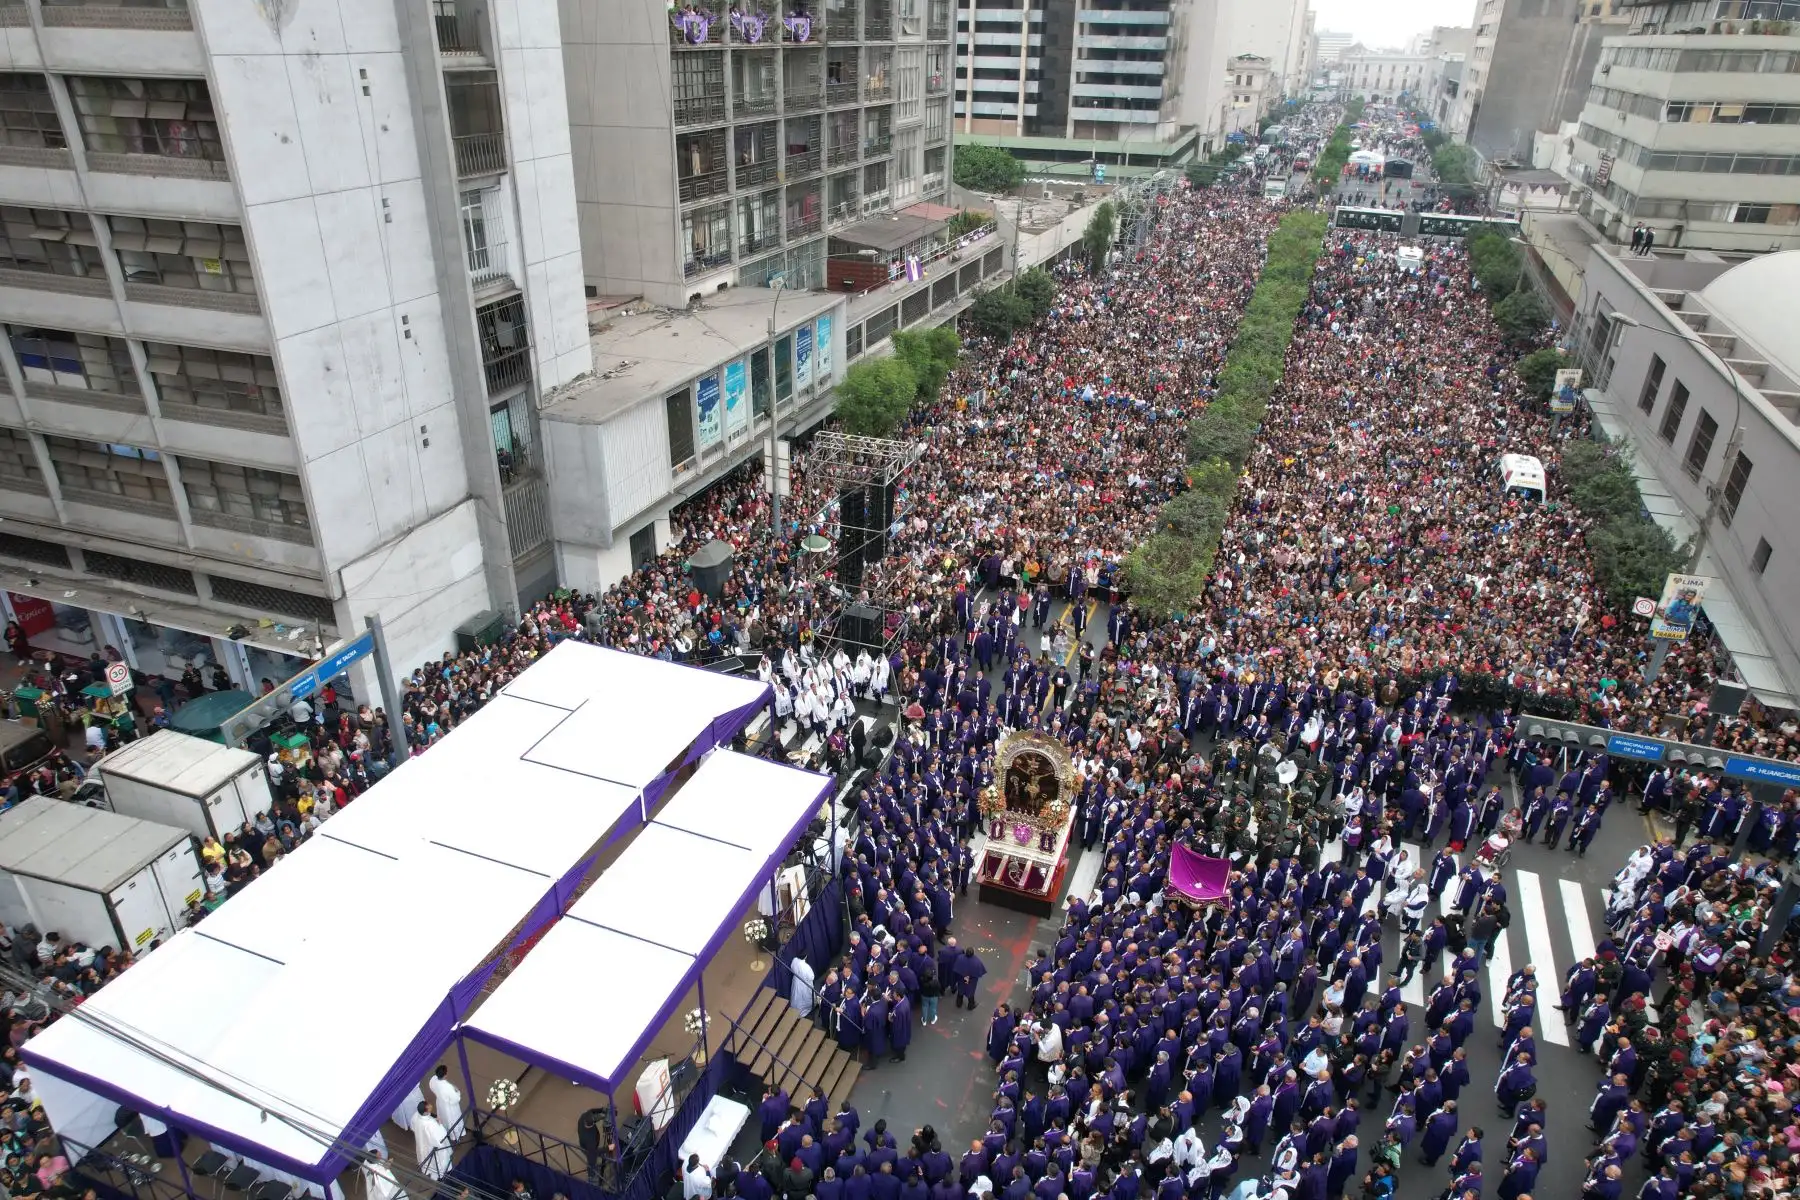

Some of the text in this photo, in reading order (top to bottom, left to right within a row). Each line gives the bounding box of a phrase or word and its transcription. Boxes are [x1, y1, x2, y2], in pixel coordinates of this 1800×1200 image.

[1640, 602, 1650, 610] 50
[112, 668, 124, 678] 30
[1615, 740, 1659, 751] MUNICIPALIDAD
